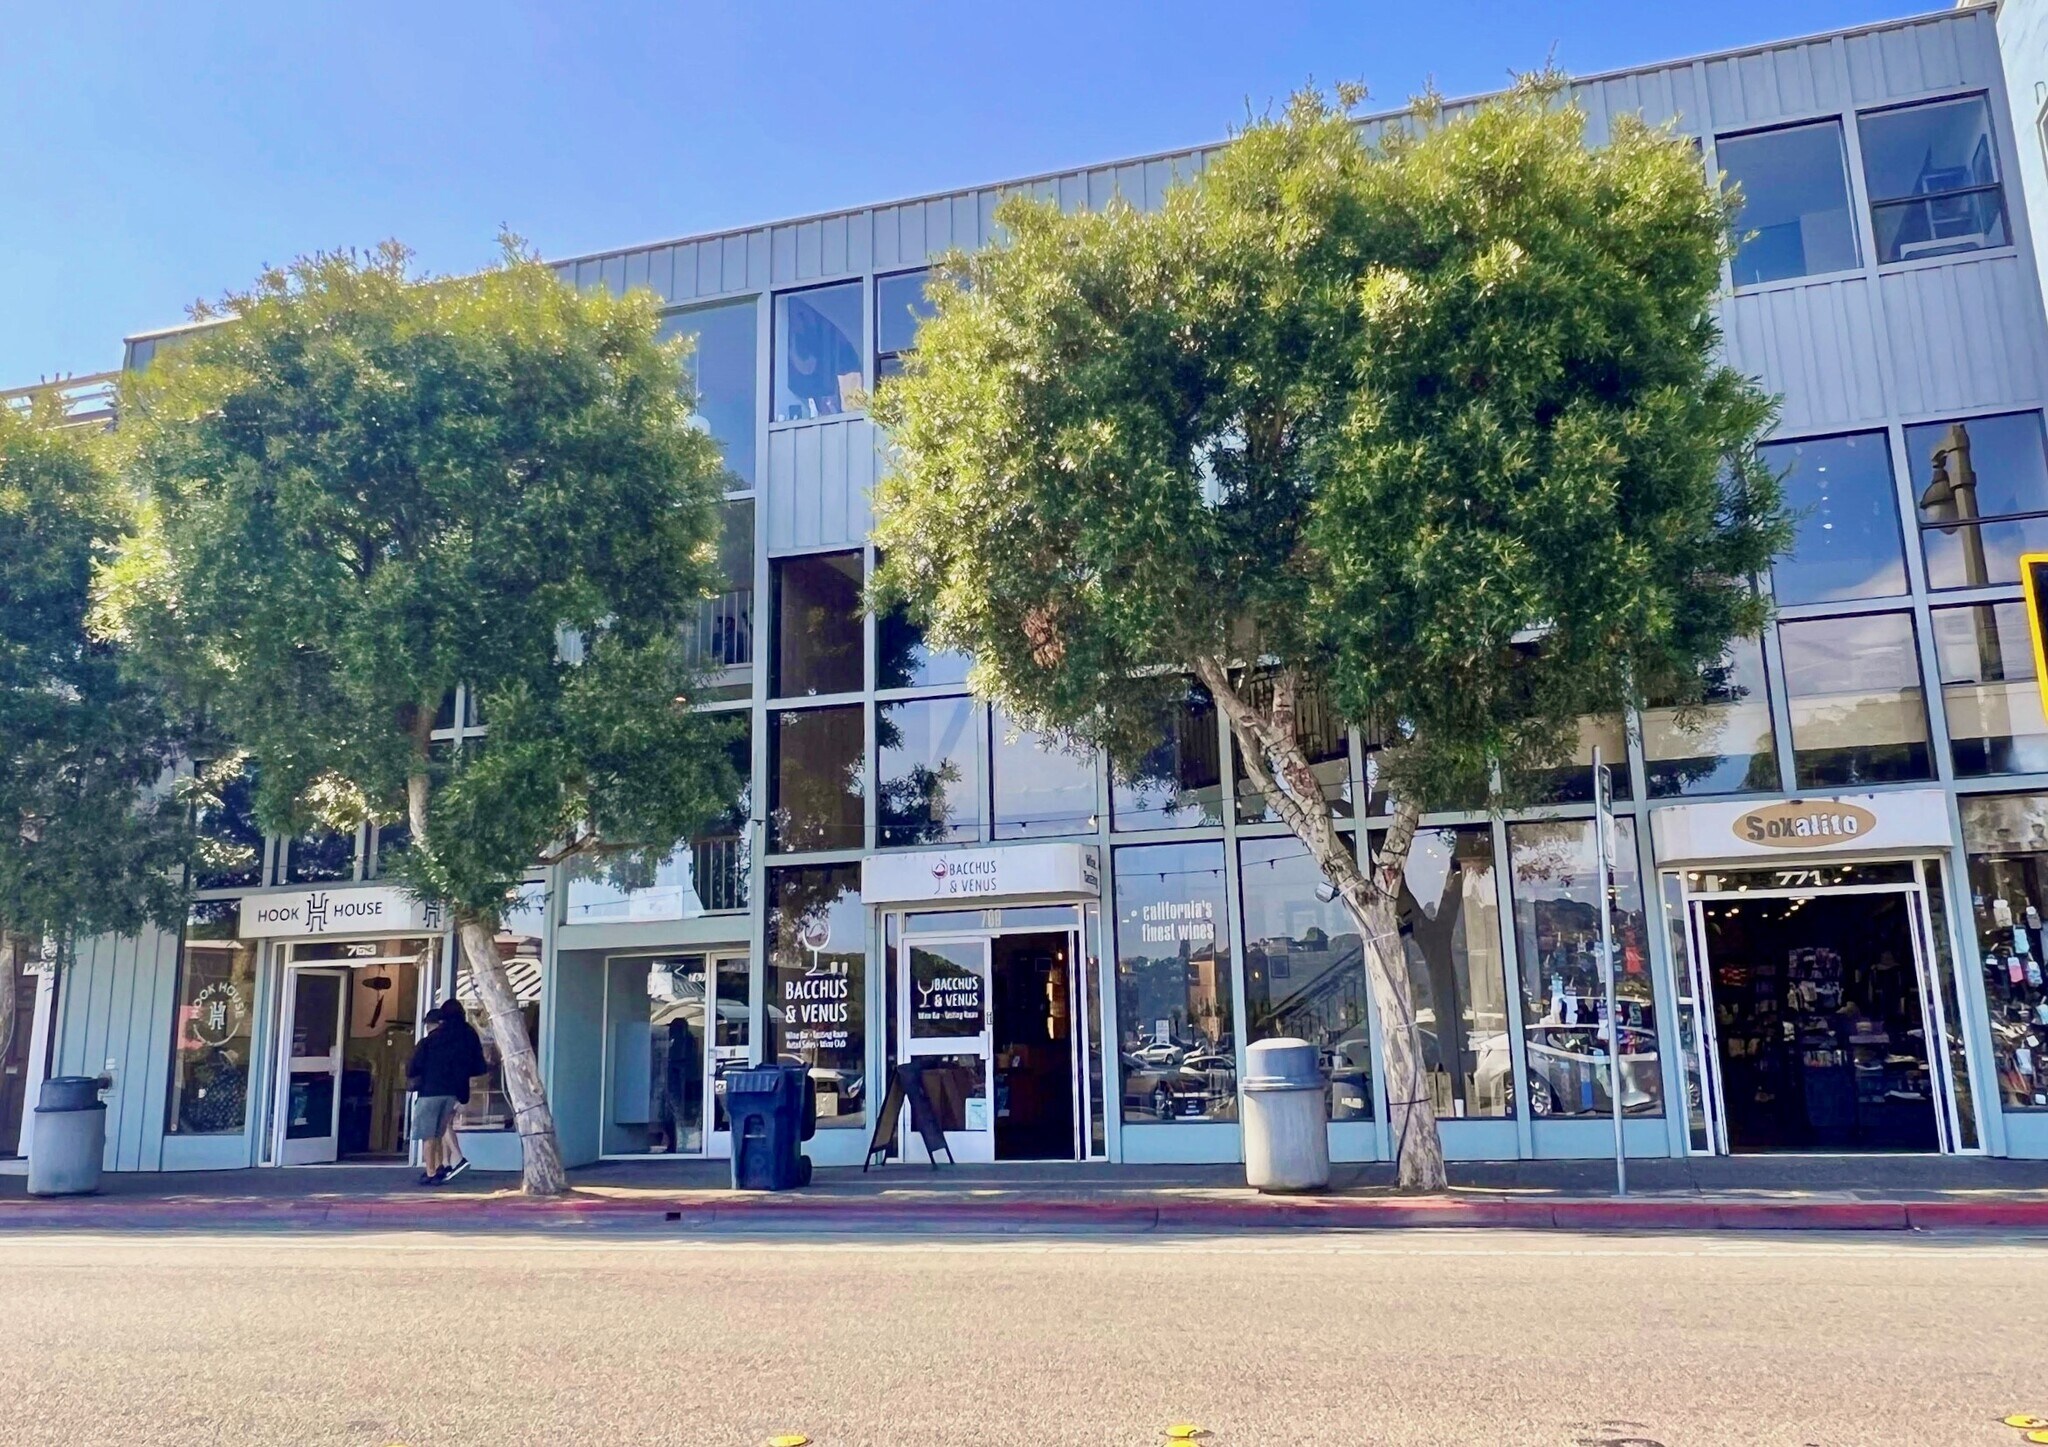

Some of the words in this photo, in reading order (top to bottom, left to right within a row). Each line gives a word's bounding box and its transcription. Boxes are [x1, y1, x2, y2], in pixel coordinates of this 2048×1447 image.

[1745, 812, 1858, 841] Soxalito
[949, 860, 997, 876] BACCHUS
[1775, 870, 1823, 887] 771
[949, 879, 958, 894] &
[961, 877, 997, 893] VENUS
[257, 906, 301, 923] HOOK
[333, 901, 383, 918] HOUSE
[1142, 899, 1213, 922] california's
[1141, 922, 1176, 943] finest
[1178, 920, 1215, 941] wines
[785, 978, 848, 1000] BACCHUS
[934, 976, 979, 991] BACCHUS
[189, 982, 216, 1019] HOOK
[218, 981, 246, 1019] HOUSE
[934, 994, 943, 1008] &
[945, 992, 979, 1007] VENUS
[785, 1004, 797, 1024] &
[800, 1002, 848, 1023] VENUS
